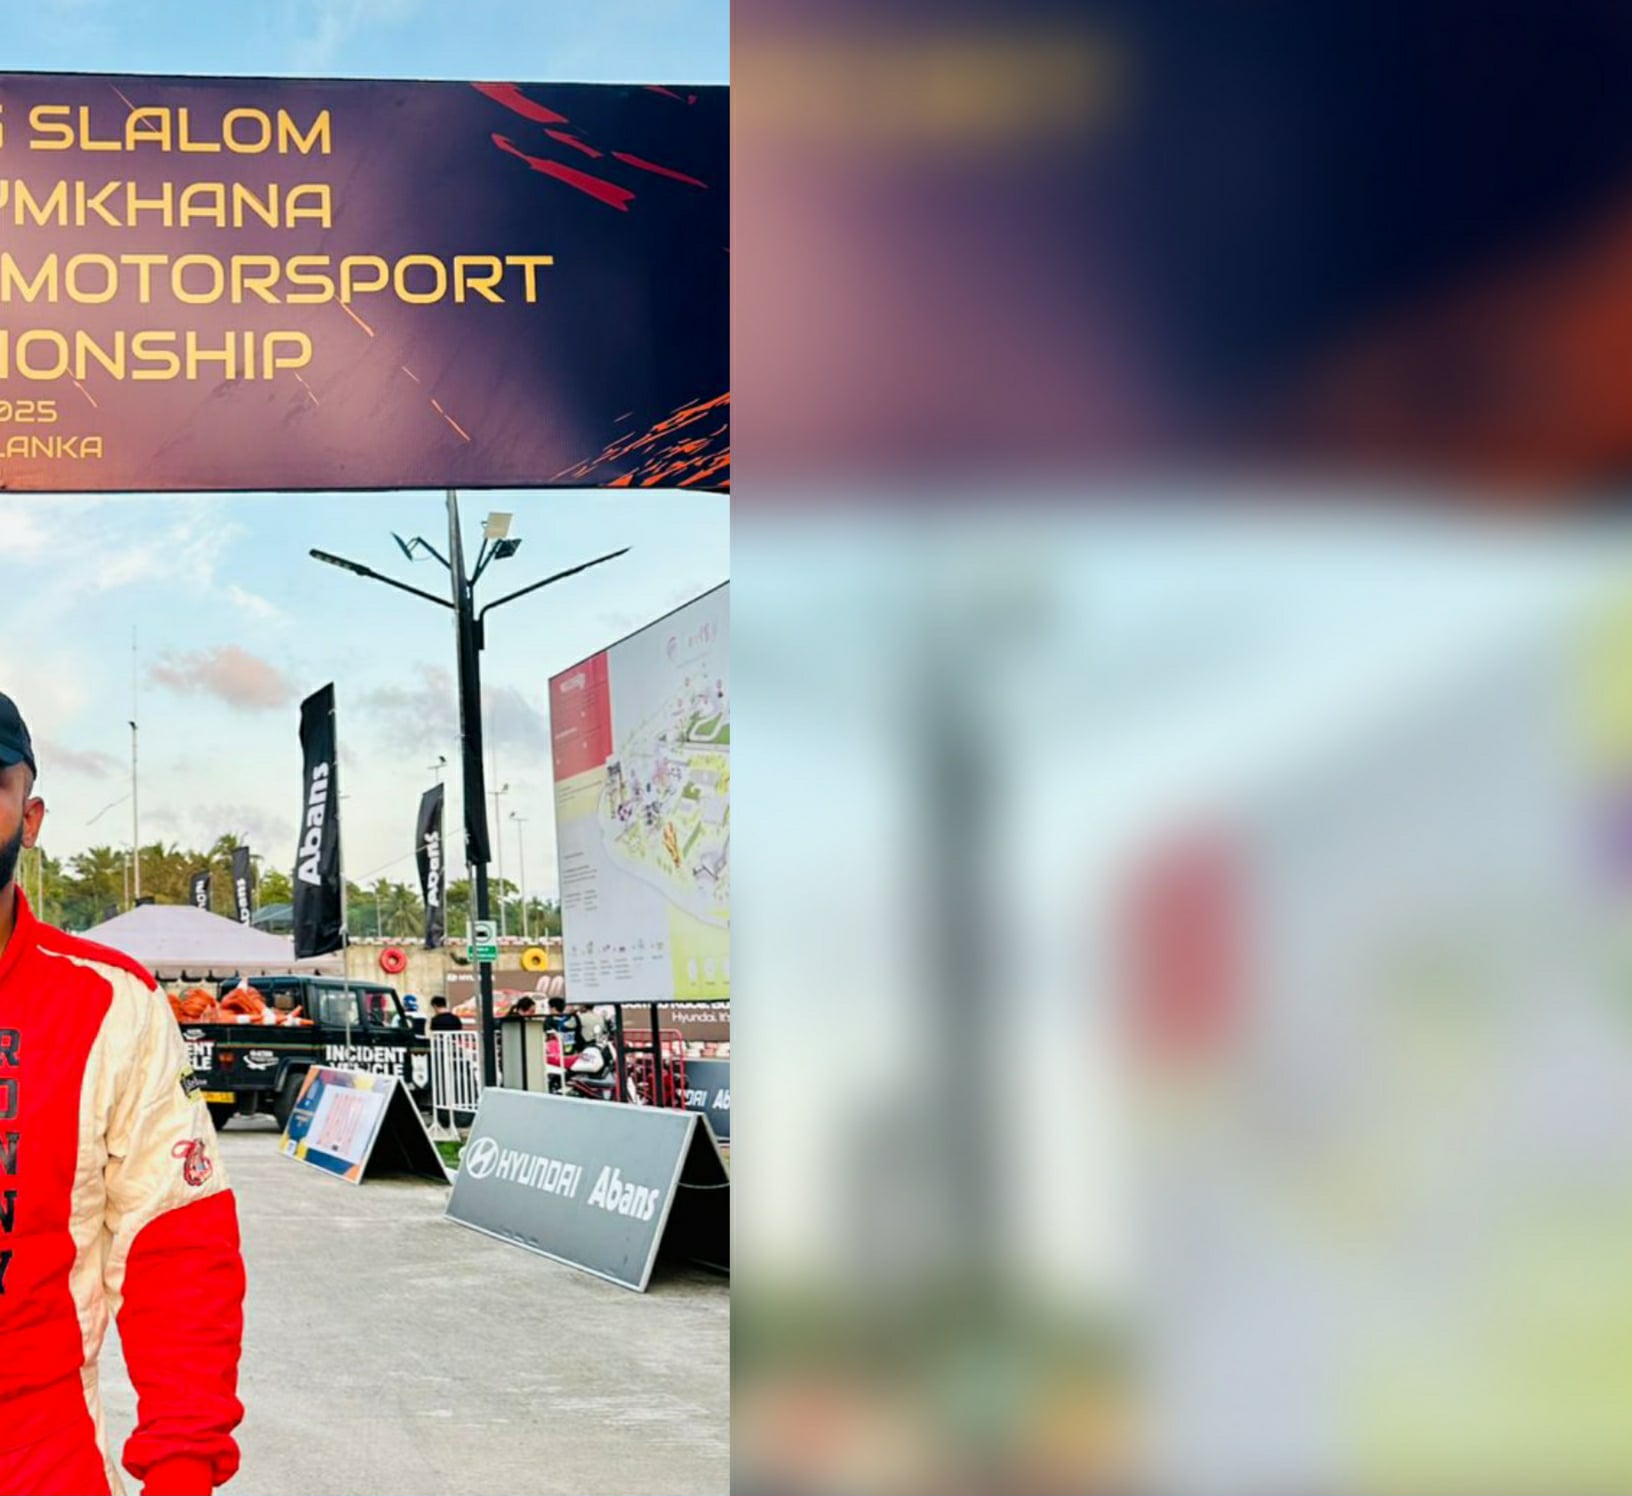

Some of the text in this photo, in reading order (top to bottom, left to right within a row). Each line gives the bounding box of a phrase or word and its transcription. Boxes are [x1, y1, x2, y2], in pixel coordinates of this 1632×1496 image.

[29, 105, 332, 154] SLALOM
[1, 252, 554, 304] MOTORSPORT
[298, 761, 329, 886] Abans
[325, 1044, 408, 1064] INCIDENT
[495, 1149, 660, 1221] HYUNDAI Abans
